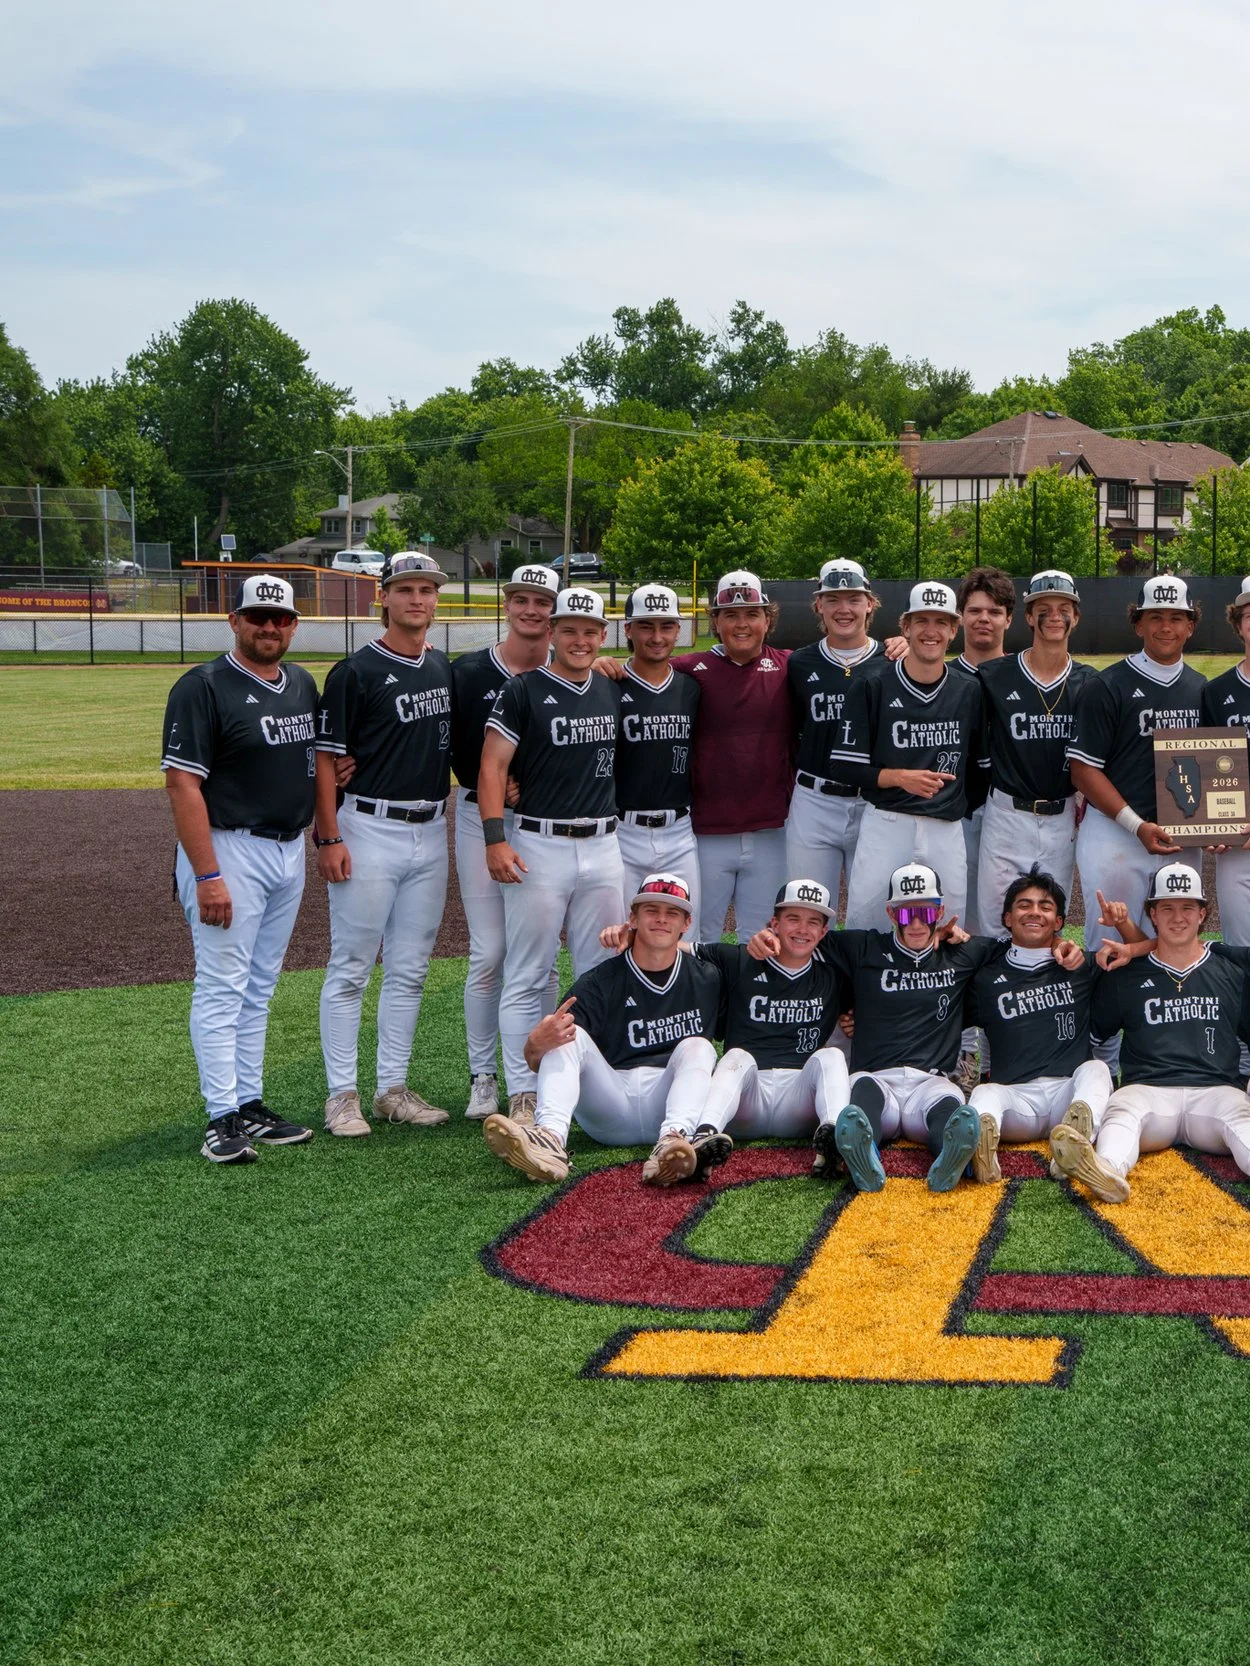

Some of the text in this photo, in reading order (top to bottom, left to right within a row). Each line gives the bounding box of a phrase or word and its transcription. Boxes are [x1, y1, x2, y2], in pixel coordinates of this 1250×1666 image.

[35, 598, 52, 606] THE
[53, 599, 91, 607] BRONCO
[411, 687, 449, 703] MONTINI
[395, 692, 451, 723] CATHOLIC
[1029, 714, 1073, 723] MONTIN
[1155, 709, 1200, 719] MONTINI
[550, 716, 616, 746] CATHOLIC
[569, 715, 615, 727] MONTINI
[623, 714, 691, 743] CATHOLIC
[642, 715, 690, 724] MONTINI
[910, 721, 959, 731] MONTINI
[1010, 712, 1072, 740] CATHOLI
[892, 720, 960, 748] CATHOLIC
[1165, 739, 1237, 750] REGIONAL
[672, 746, 688, 774] 17
[937, 751, 961, 775] 27
[1212, 778, 1239, 787] 2026
[1163, 824, 1246, 836] CHAMPIONS
[880, 969, 956, 992] CATHOLIC
[1016, 981, 1072, 1000] MONTINI
[749, 995, 824, 1024] CATHOLIC
[770, 998, 823, 1008] MONTINI
[998, 988, 1075, 1020] CATHOLIC
[1144, 998, 1219, 1025] CATHOLIC
[1163, 996, 1219, 1006] MONTINI
[646, 1008, 701, 1027] MONTINI
[1055, 1012, 1076, 1041] 16
[628, 1017, 704, 1048] CATHOLIC
[796, 1027, 821, 1054] 13
[1205, 1027, 1216, 1055] 1
